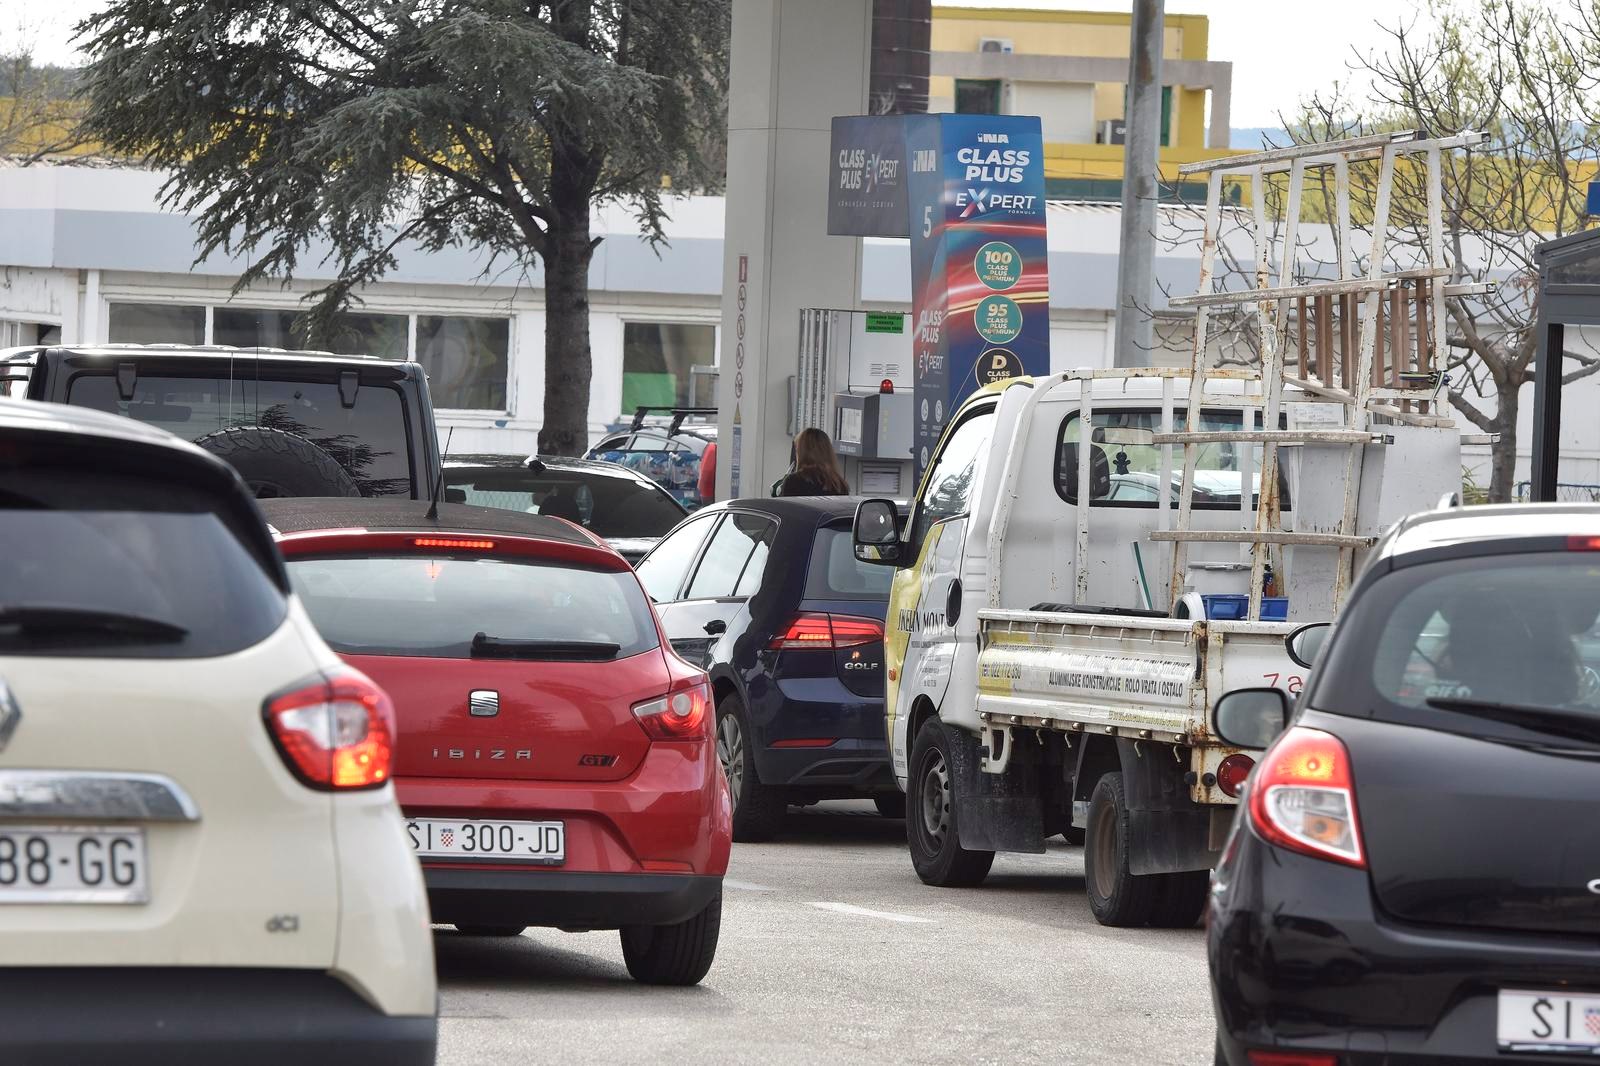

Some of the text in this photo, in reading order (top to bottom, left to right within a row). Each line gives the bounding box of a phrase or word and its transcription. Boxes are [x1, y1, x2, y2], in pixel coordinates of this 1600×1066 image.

[839, 149, 865, 169] CLASS
[957, 148, 1030, 167] CLASS
[840, 171, 862, 189] PLUS
[965, 166, 1024, 183] PLUS
[955, 188, 1037, 217] EXPERT
[923, 206, 932, 238] 5
[985, 251, 1013, 264] 100
[919, 310, 942, 327] CLASS
[988, 304, 1008, 317] 95
[921, 328, 940, 343] PLUS
[992, 355, 1007, 369] D
[844, 662, 878, 670] GOLF
[1124, 678, 1140, 693] ROLO
[1141, 680, 1157, 695] VRATA
[1161, 681, 1183, 698] OSTALO
[432, 749, 532, 760] IBIZA
[461, 824, 560, 854] 300-JD
[0, 836, 136, 886] 88-GG
[1531, 998, 1571, 1040] ŠI
